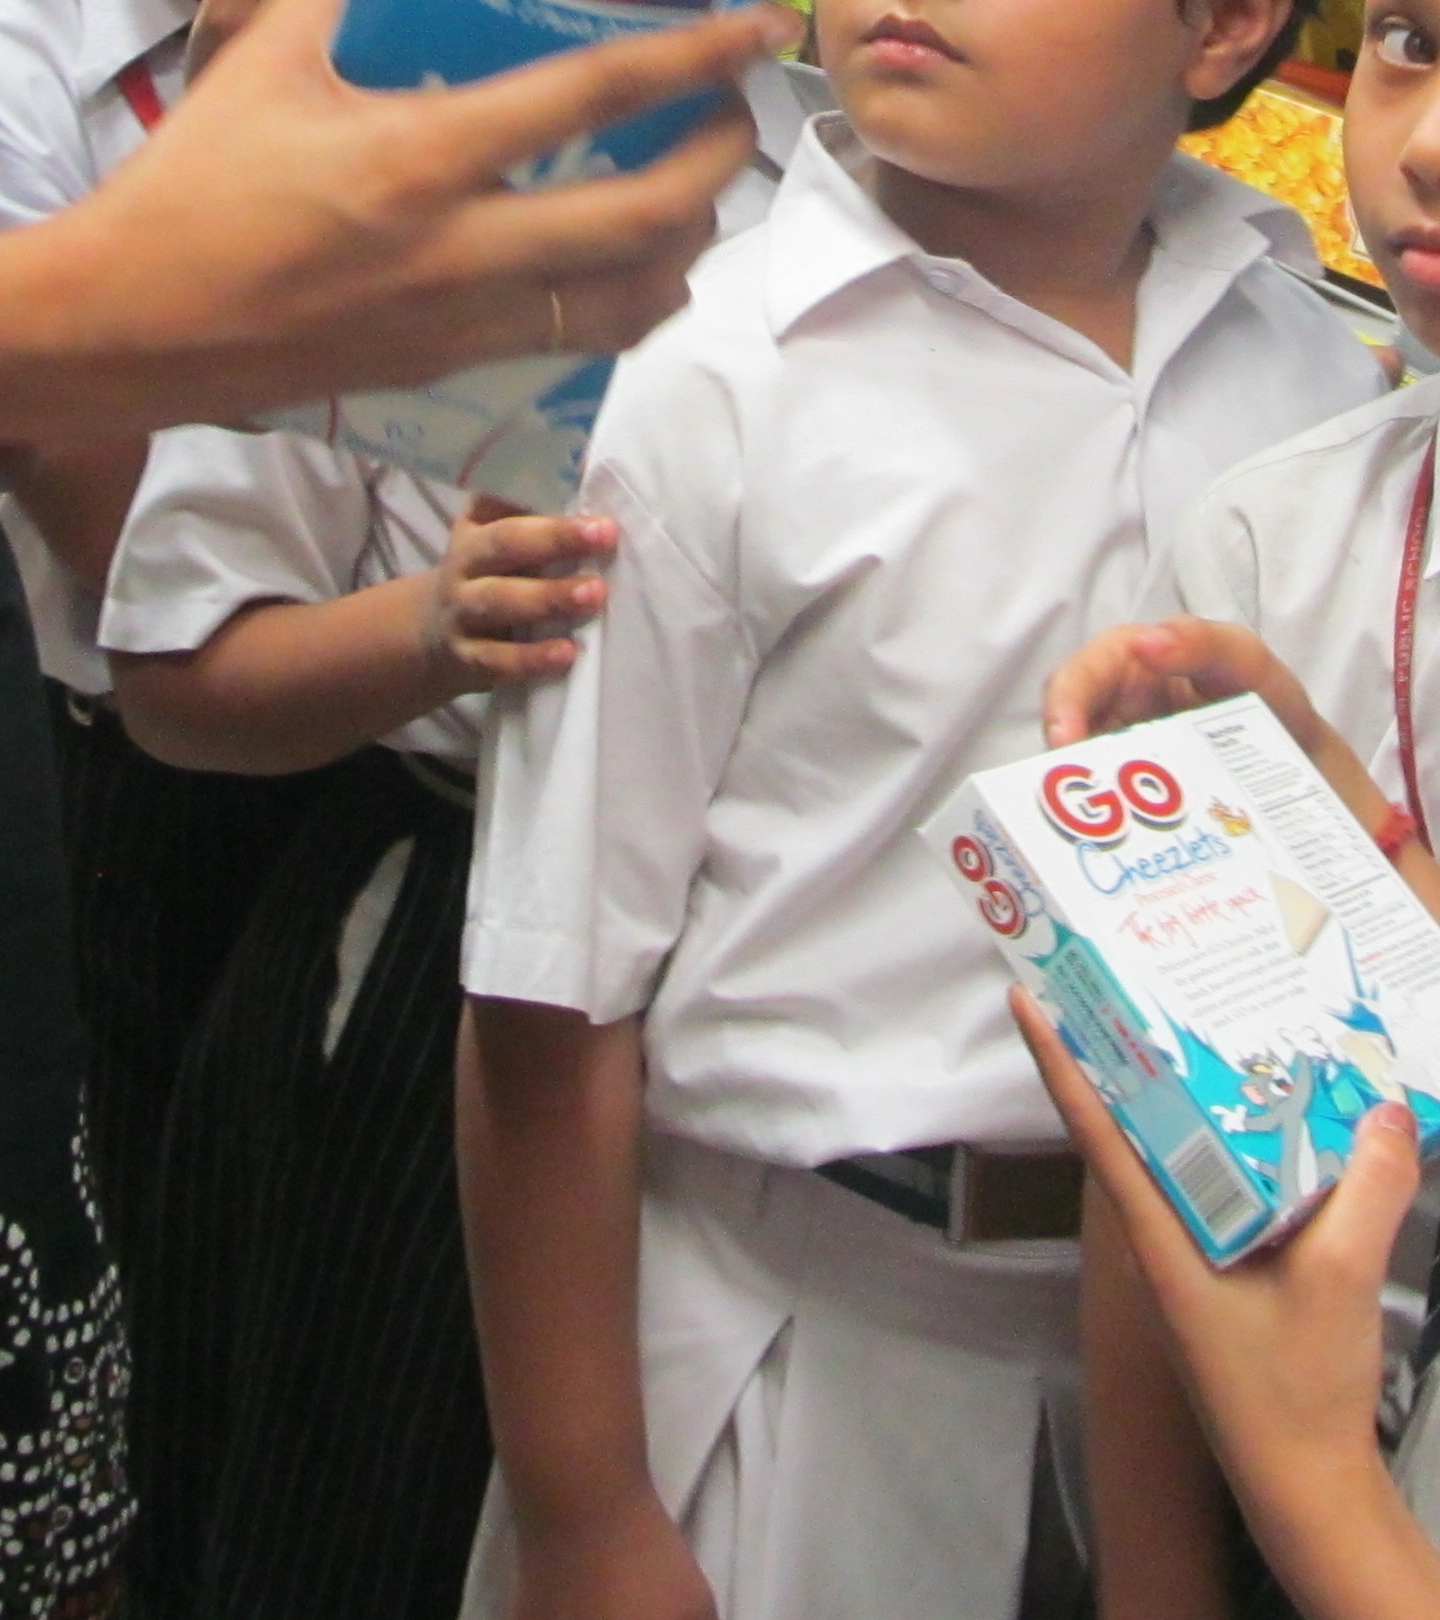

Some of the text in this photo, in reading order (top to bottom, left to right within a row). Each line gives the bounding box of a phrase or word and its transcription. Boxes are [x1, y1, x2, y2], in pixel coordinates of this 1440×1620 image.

[1403, 506, 1427, 592] SCHOOL
[1396, 598, 1415, 685] PUBLIC
[1039, 758, 1188, 850] GO
[951, 835, 1028, 940] GO
[1075, 825, 1233, 896] Cheezlets
